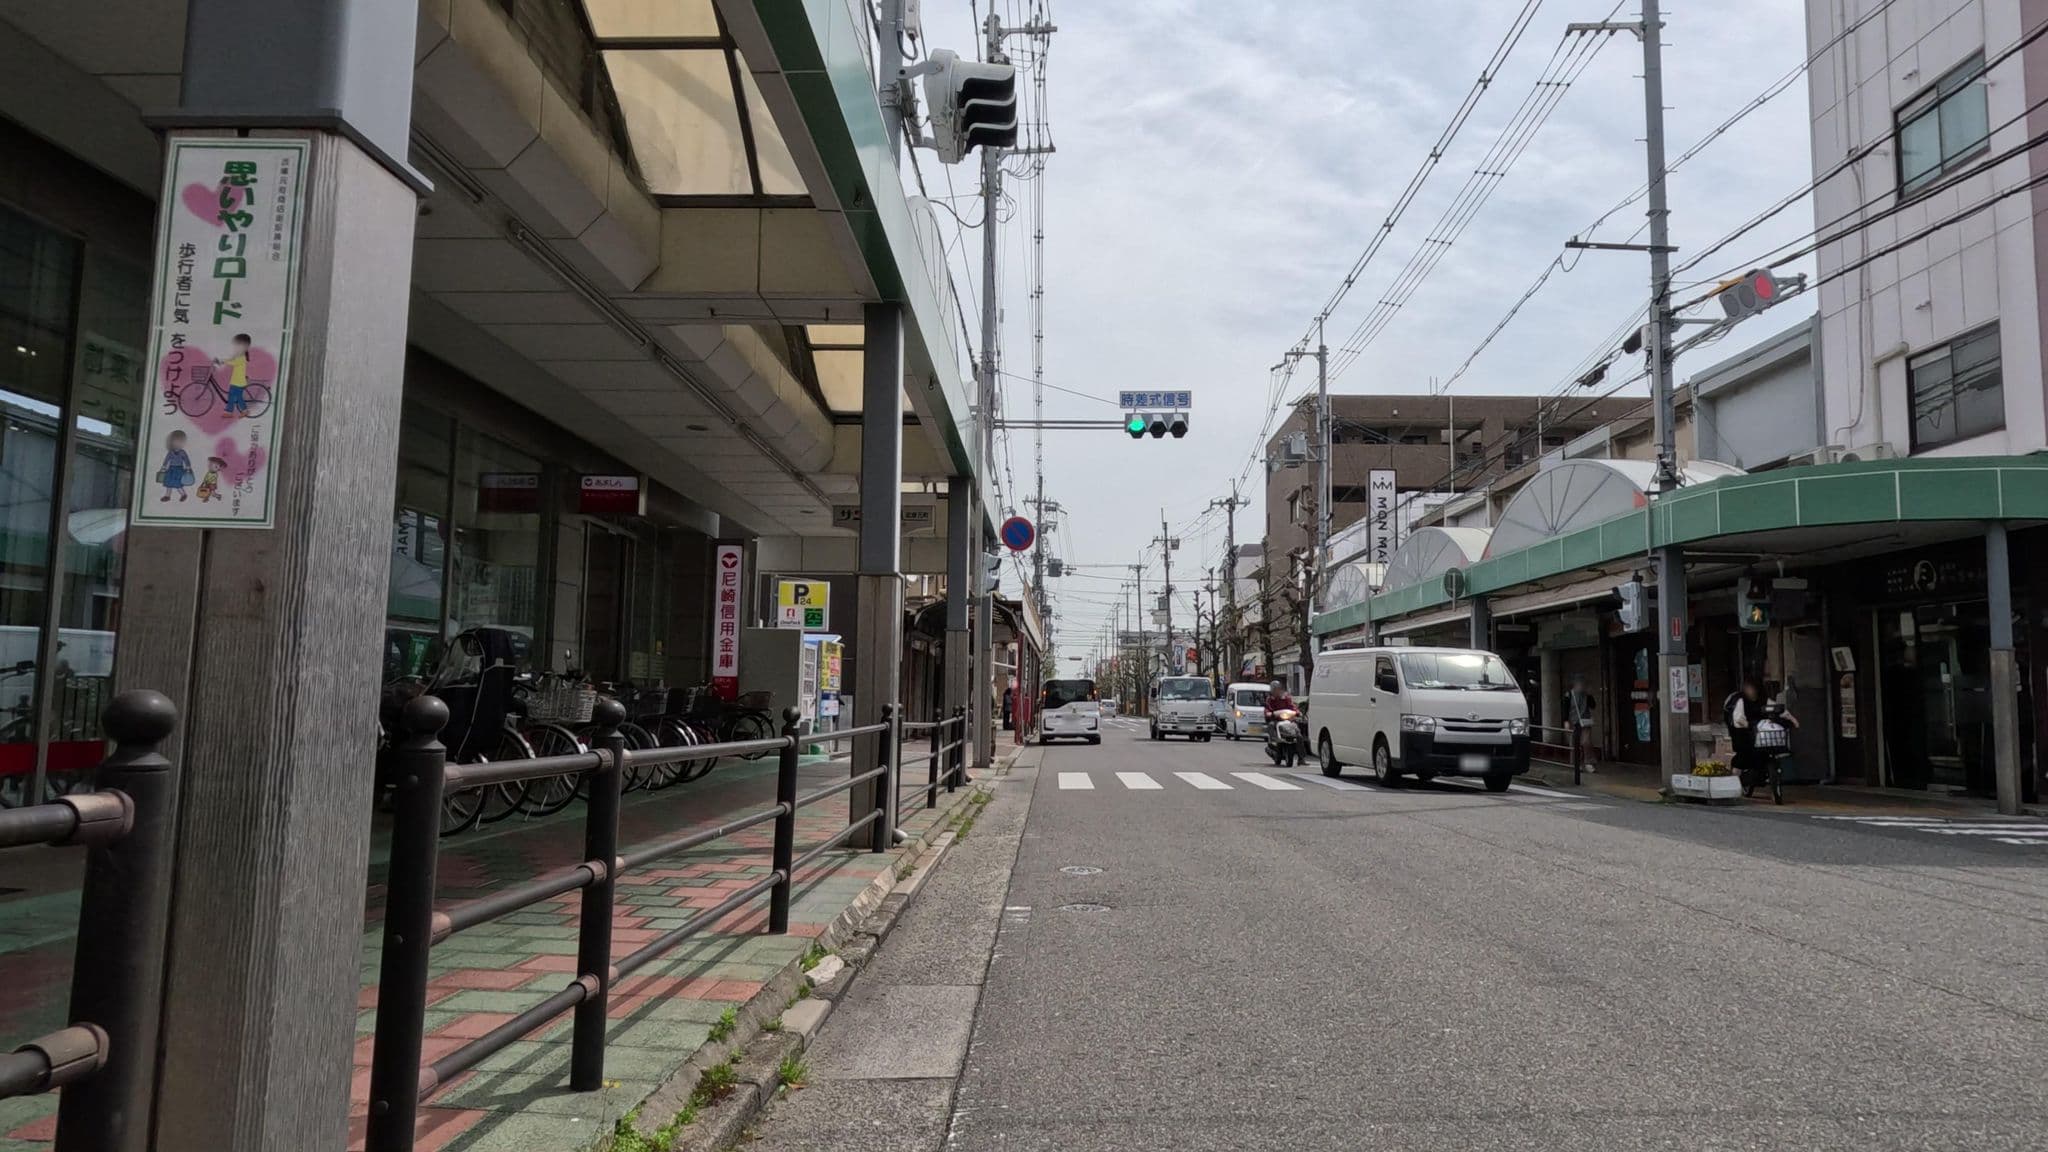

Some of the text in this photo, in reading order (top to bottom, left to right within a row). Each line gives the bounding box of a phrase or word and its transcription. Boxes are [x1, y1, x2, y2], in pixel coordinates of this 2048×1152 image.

[212, 160, 258, 326] 思いやりロード
[1121, 392, 1189, 407] 時差式信号
[1377, 497, 1388, 531] MON
[794, 583, 812, 606] P 24
[718, 571, 737, 670] 尼崎信用金庫
